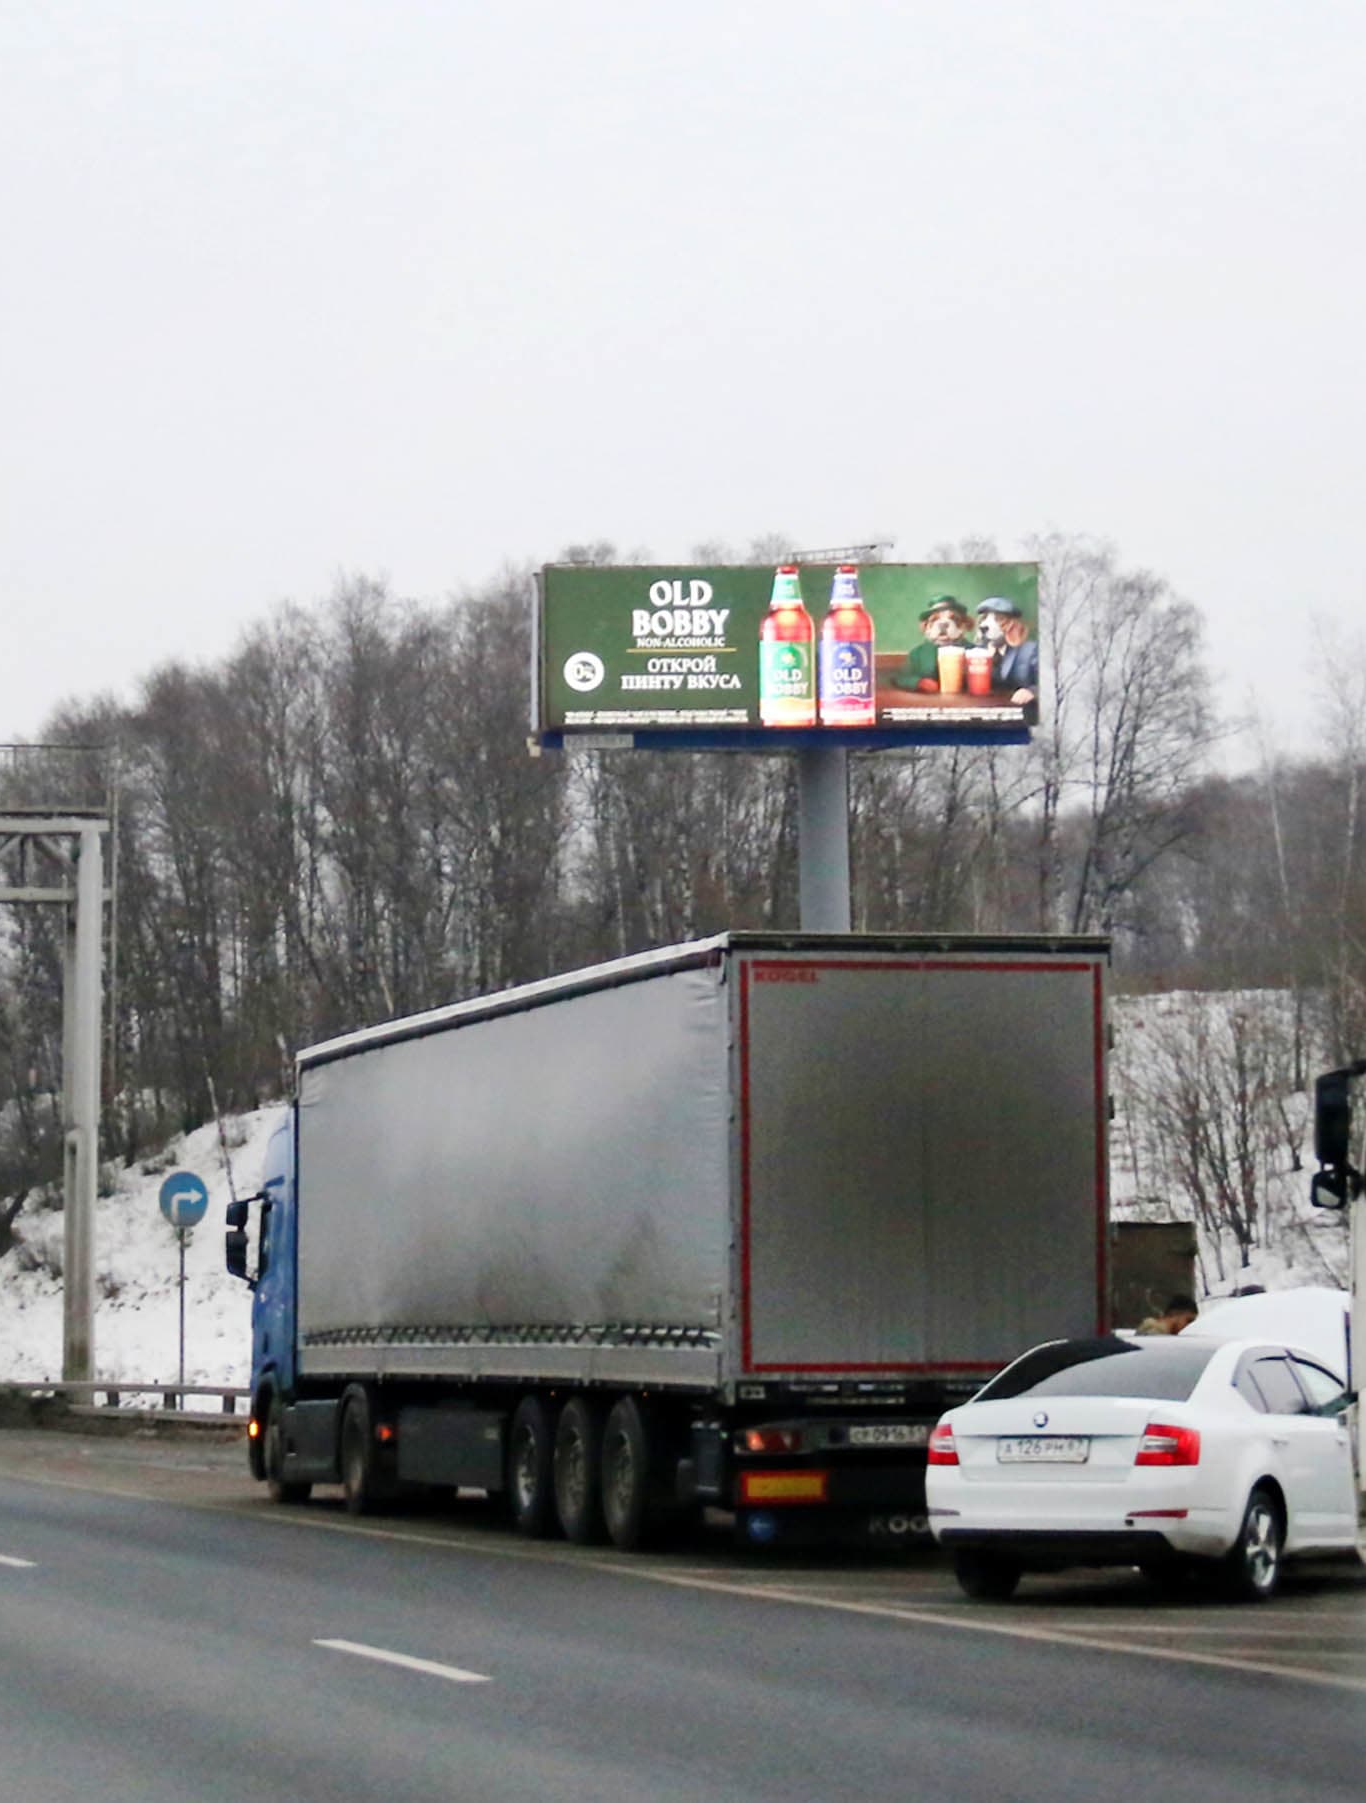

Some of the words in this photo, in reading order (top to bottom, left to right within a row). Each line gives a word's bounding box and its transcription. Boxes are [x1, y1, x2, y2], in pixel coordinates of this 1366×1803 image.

[650, 580, 713, 607] OLD
[632, 609, 730, 636] BOBBY
[636, 637, 726, 648] NON-ALCOHOLIC
[647, 655, 717, 673] ОТКРОЙ
[621, 675, 684, 689] ПИНТУ
[687, 674, 742, 689] ВКУСА
[833, 669, 862, 681] OLD
[828, 682, 868, 695] OBBY
